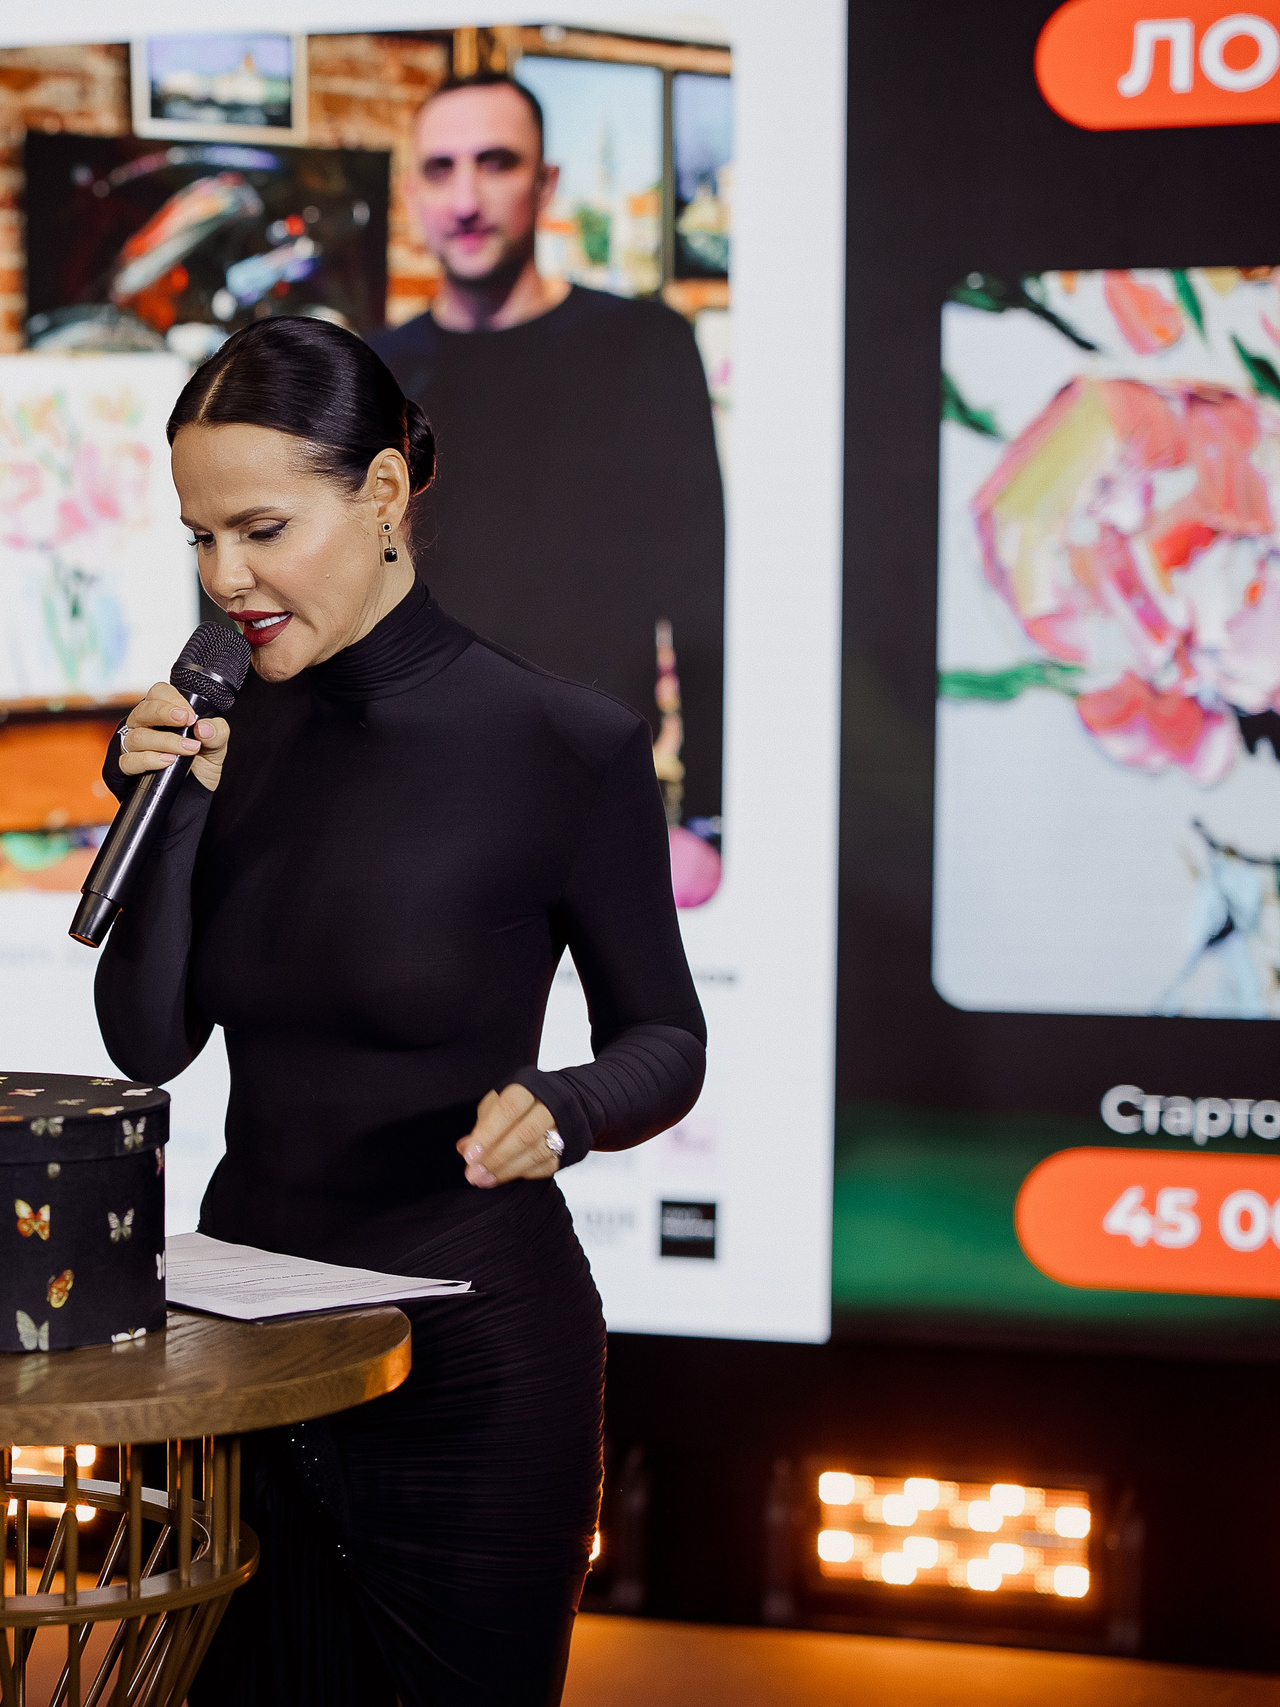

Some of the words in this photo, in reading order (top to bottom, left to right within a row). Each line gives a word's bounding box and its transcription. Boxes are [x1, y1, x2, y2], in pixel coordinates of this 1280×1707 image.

[1117, 13, 1280, 98] ЛО
[1100, 1084, 1280, 1146] Старто
[1101, 1185, 1202, 1249] 45
[1217, 1189, 1280, 1252] 0
